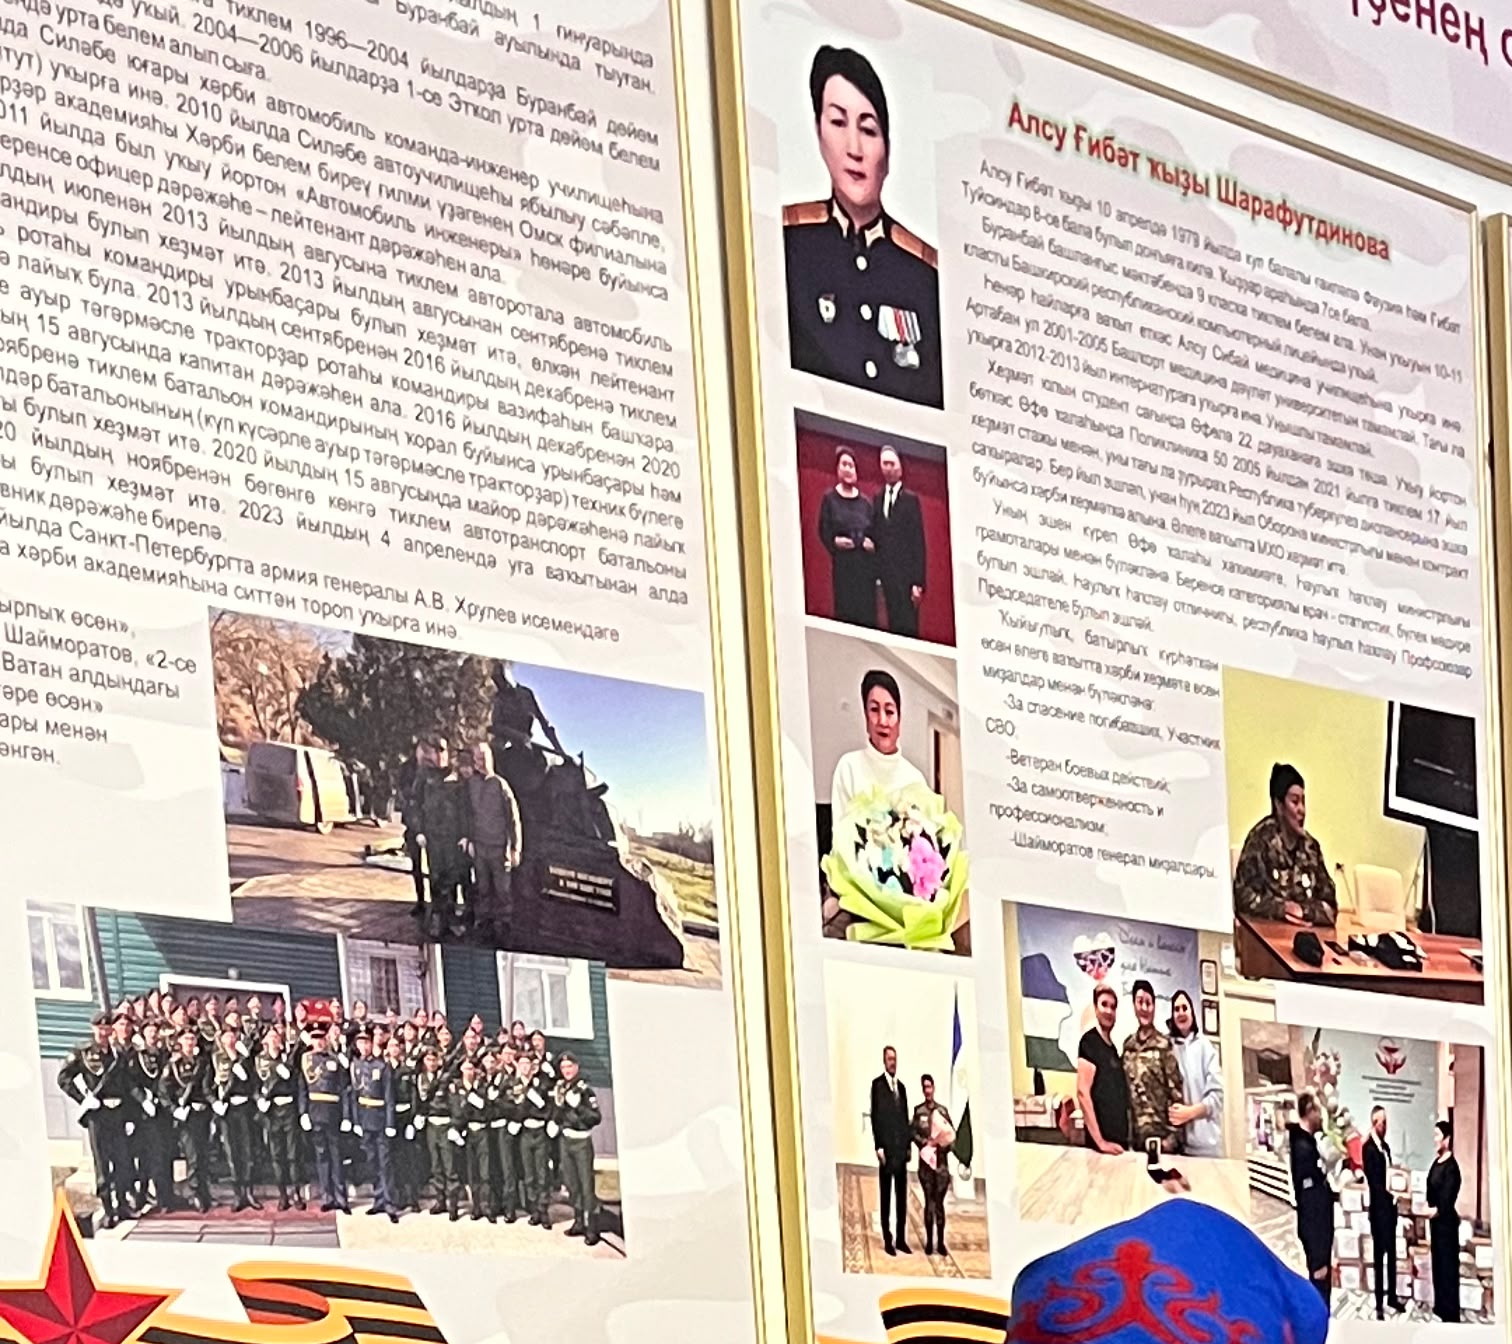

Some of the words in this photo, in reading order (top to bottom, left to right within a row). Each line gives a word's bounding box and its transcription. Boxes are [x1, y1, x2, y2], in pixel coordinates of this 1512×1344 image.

[1008, 102, 1067, 152] Алсу
[1074, 125, 1140, 174] Ғибәт
[1216, 177, 1390, 262] Шарафутдинова
[1, 651, 62, 679] Ватан
